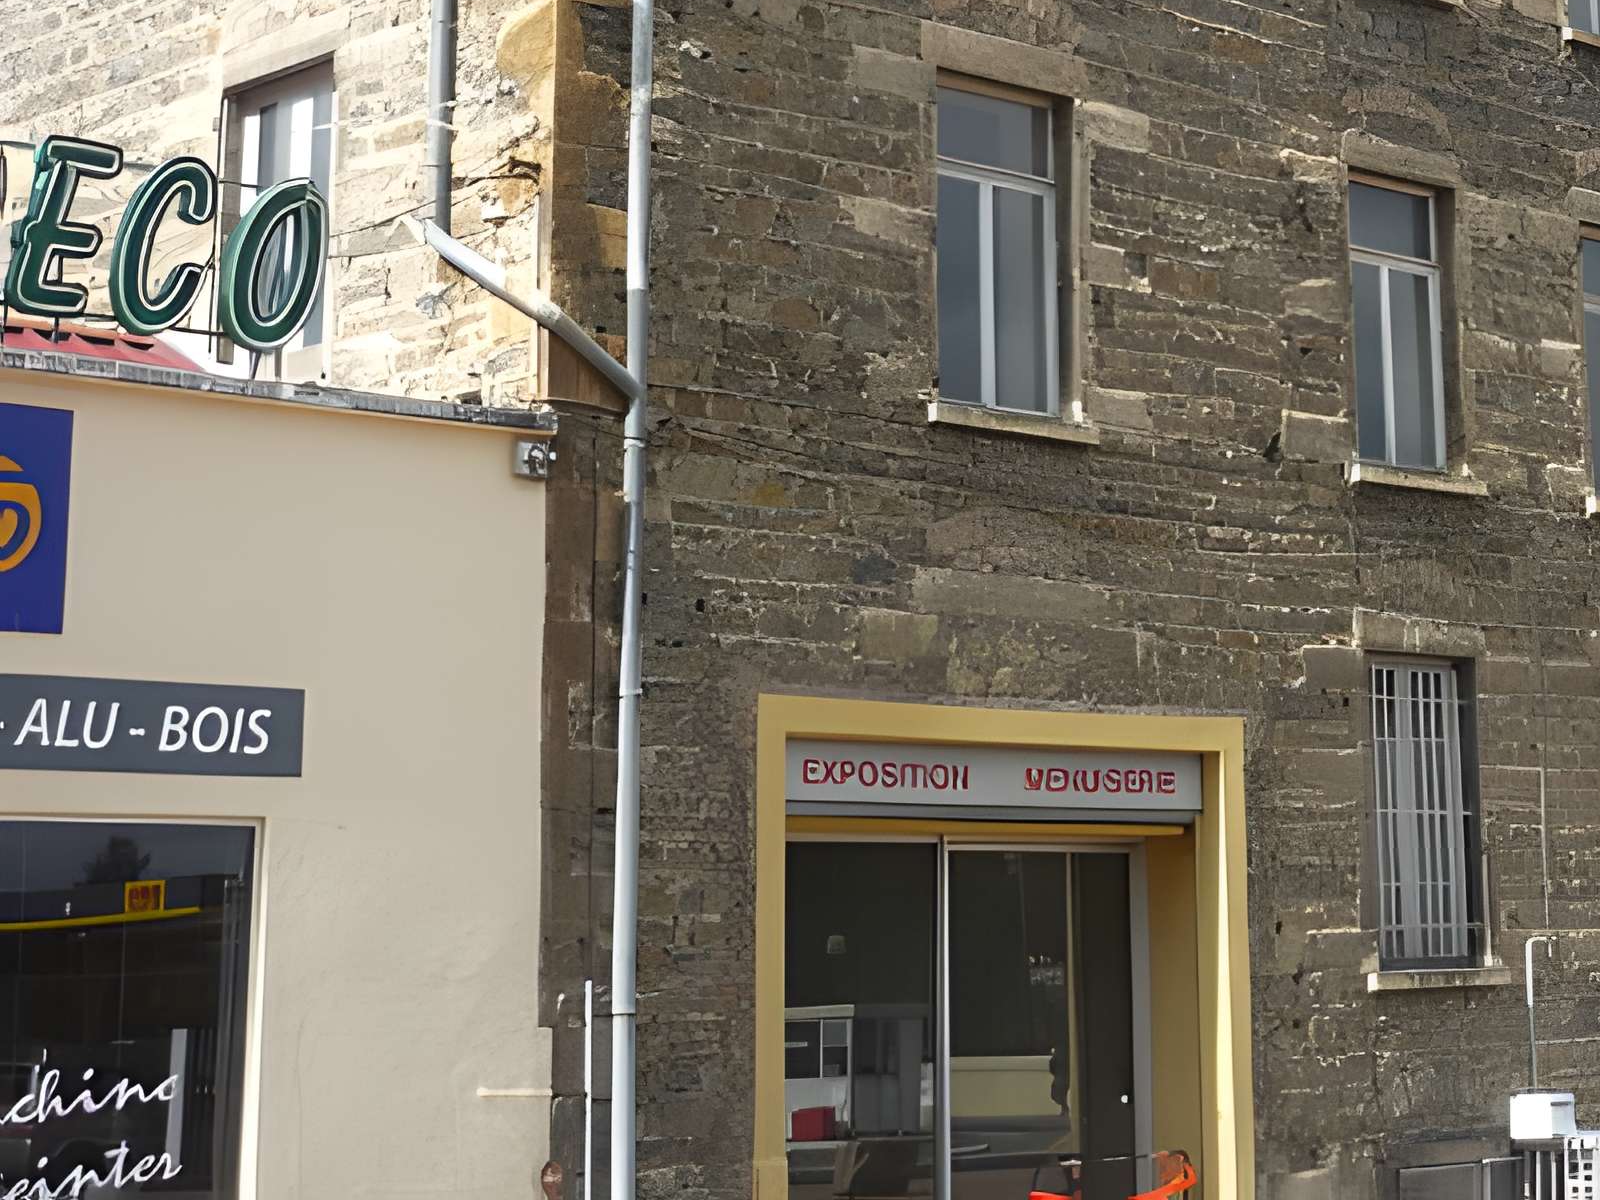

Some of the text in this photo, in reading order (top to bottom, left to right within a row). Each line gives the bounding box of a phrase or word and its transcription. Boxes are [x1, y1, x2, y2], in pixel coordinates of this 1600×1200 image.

[0, 135, 328, 352] ECO
[13, 697, 120, 749] ALU
[158, 705, 272, 755] BOIS
